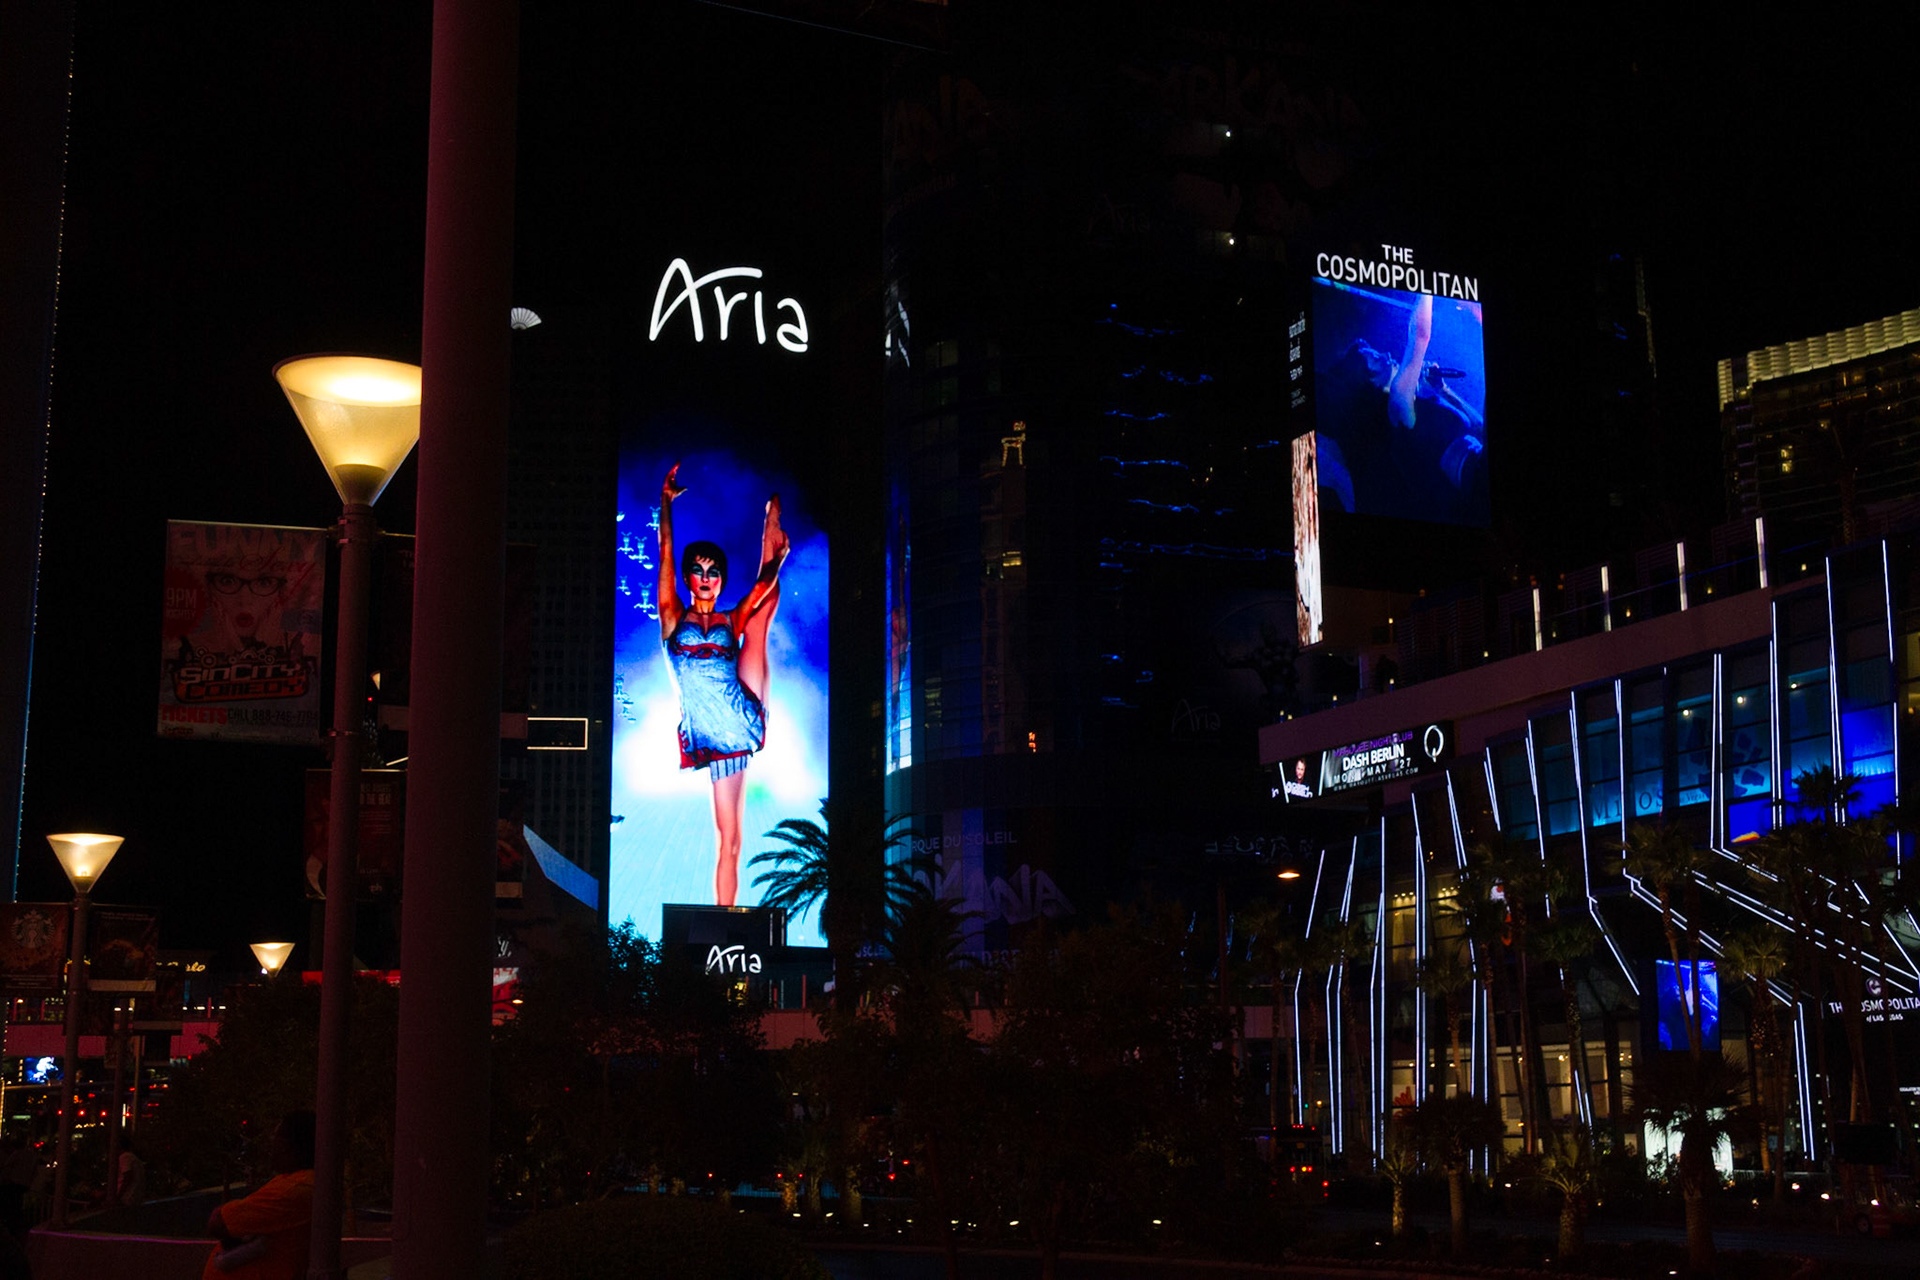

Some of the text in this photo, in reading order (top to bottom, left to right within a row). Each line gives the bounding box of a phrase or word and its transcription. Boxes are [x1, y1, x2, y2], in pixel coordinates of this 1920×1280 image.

[1381, 244, 1415, 265] THE
[1317, 252, 1480, 302] COSMOPOLITAN
[649, 257, 809, 352] Aria
[166, 587, 198, 609] 9PM
[161, 704, 228, 725] TICKETS
[1342, 743, 1405, 771] DASH BERLIN
[1366, 763, 1388, 777] MAY
[705, 944, 763, 976] Aria
[1828, 1001, 1845, 1014] TH
